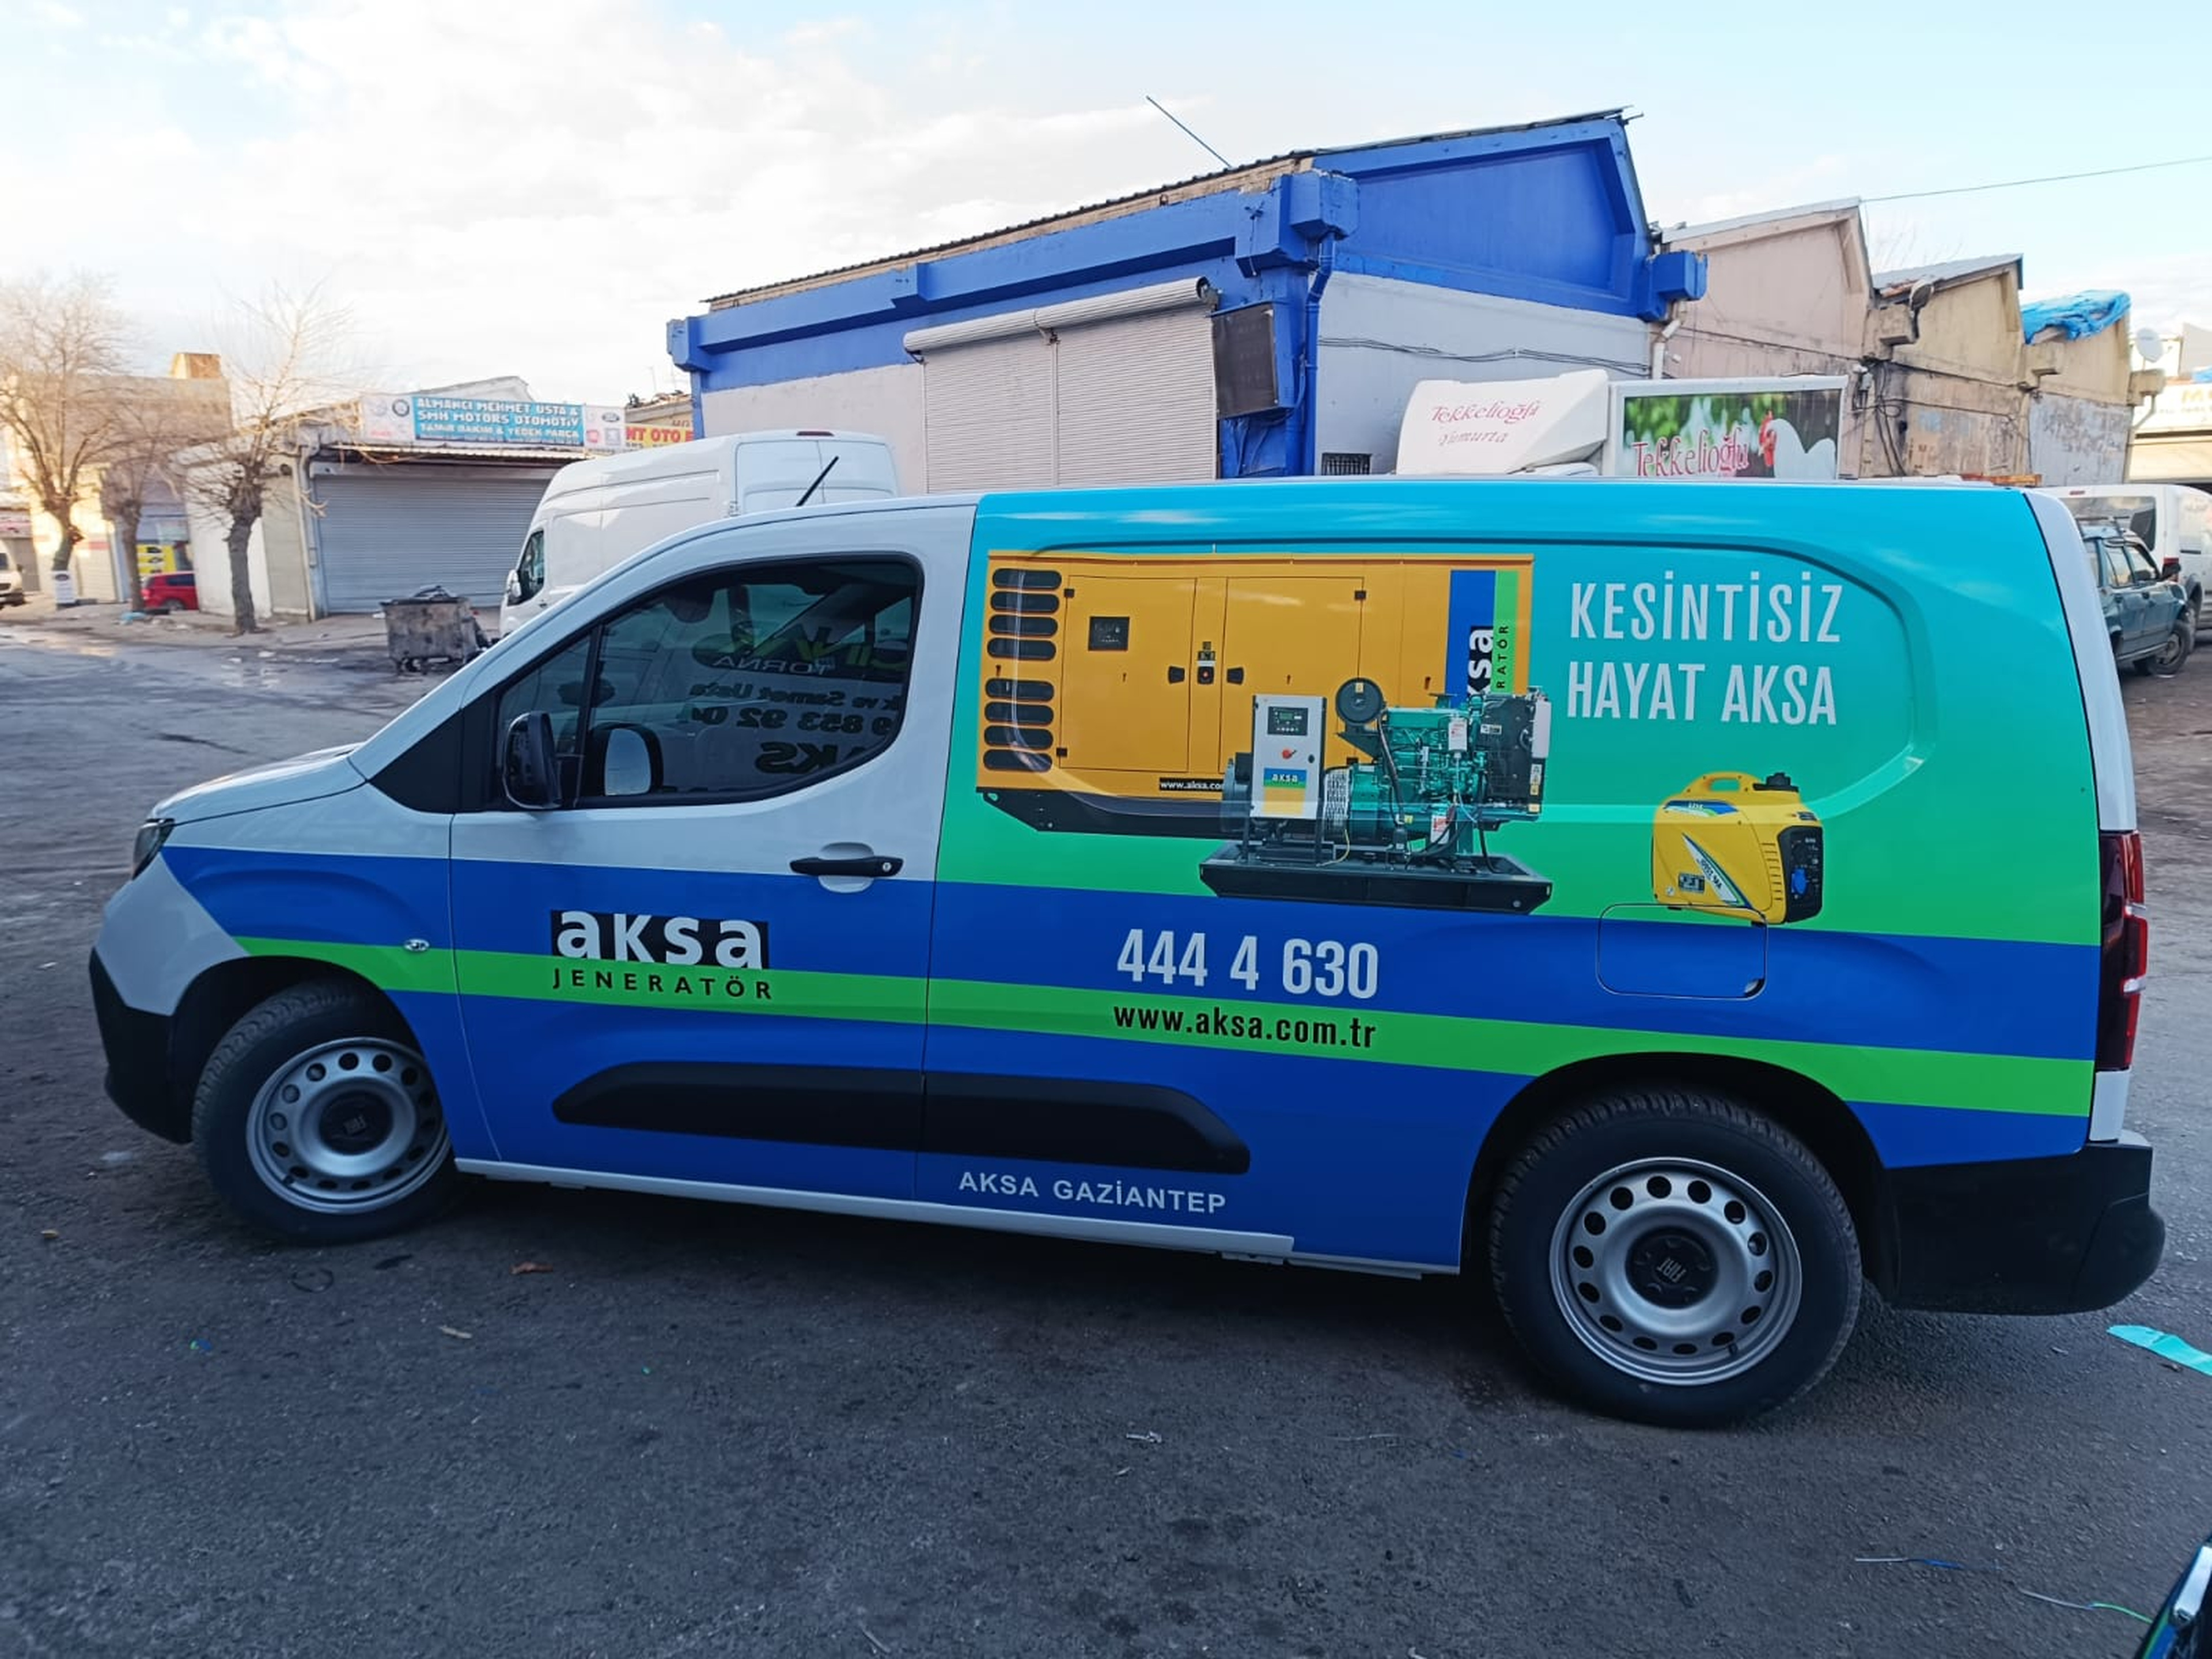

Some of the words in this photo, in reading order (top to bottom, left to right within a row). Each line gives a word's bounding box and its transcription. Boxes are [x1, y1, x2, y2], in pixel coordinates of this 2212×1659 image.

[453, 412, 509, 423] MOTORS
[476, 401, 531, 413] MEHMET
[536, 404, 566, 414] USTA
[652, 429, 680, 442] OTO
[1570, 571, 1843, 642] KESİNTİSİZ
[1567, 661, 1705, 720] HAYAT
[1721, 665, 1836, 725] AKSA
[1160, 781, 1224, 790] www.aksa.co
[1271, 774, 1298, 782] aksa
[557, 910, 762, 969] aksa
[1117, 929, 1208, 986] 444
[1230, 935, 1259, 990] 4
[1282, 938, 1378, 999] 630
[552, 968, 771, 1000] JENERATÖR
[1113, 1006, 1376, 1047] www.aksa.com.tr
[959, 1172, 1039, 1197] AKSA
[1053, 1180, 1226, 1213] GAZİANTEP
